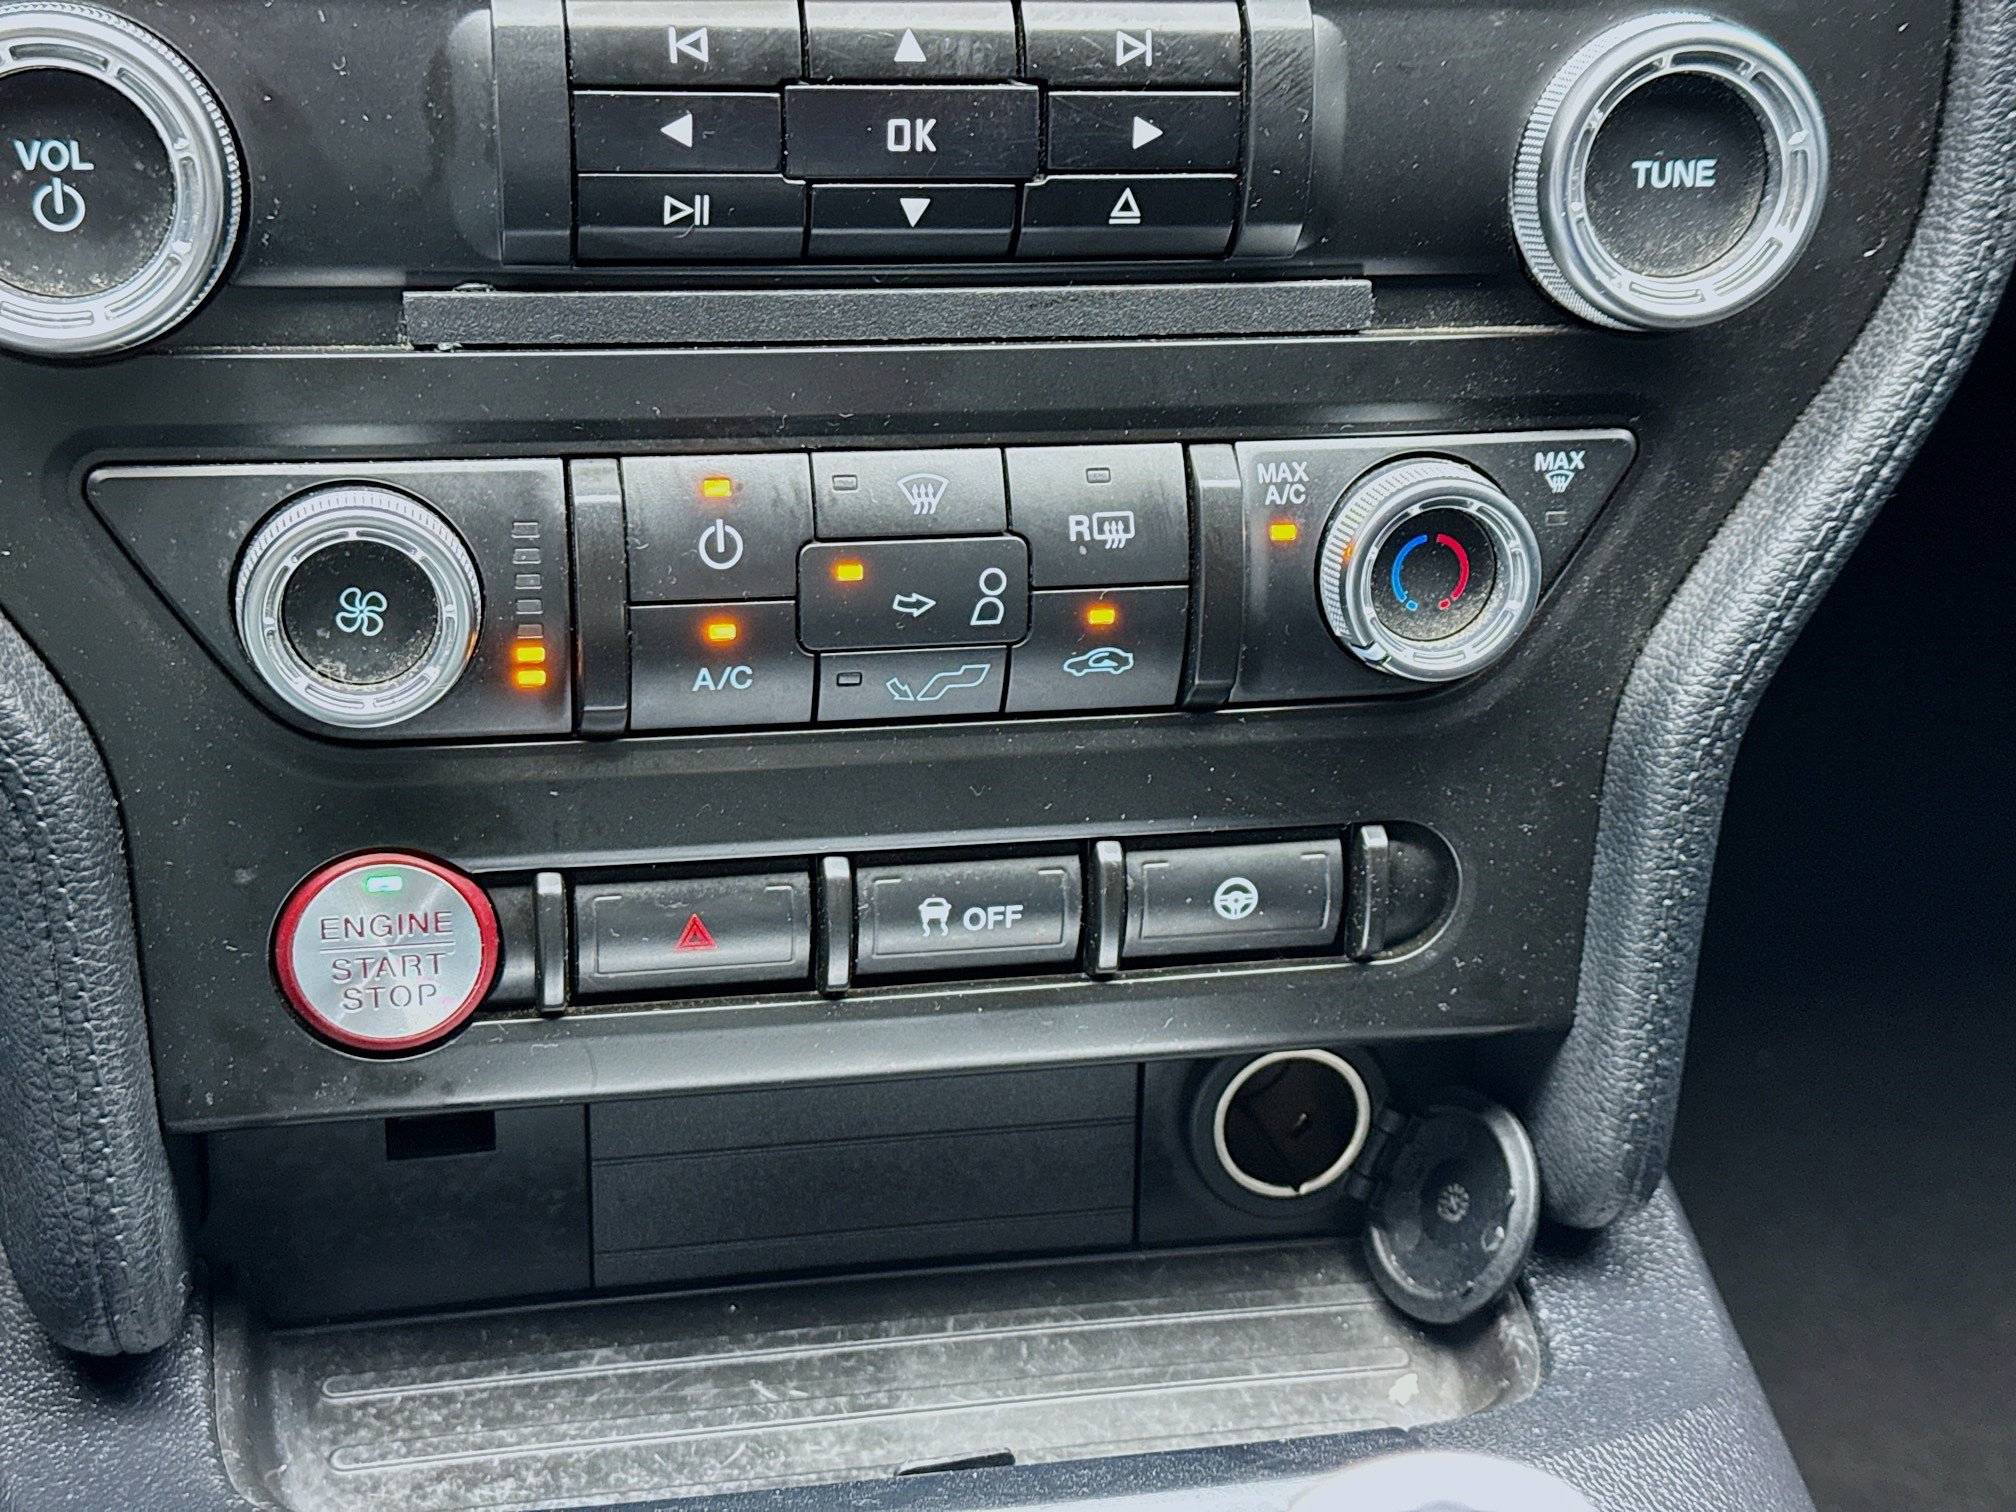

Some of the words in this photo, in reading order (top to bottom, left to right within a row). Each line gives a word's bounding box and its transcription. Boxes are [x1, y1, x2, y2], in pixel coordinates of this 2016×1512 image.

[887, 118, 937, 153] OK
[14, 139, 94, 172] VOL
[1632, 158, 1717, 190] TUNE
[1257, 461, 1309, 483] MAX
[1534, 450, 1586, 473] MAX
[1264, 483, 1306, 505] A/C
[692, 664, 753, 692] A/C
[319, 910, 453, 941] ENGINE
[962, 903, 1024, 932] OFF
[331, 950, 446, 983] START
[342, 983, 438, 1011] STOP
